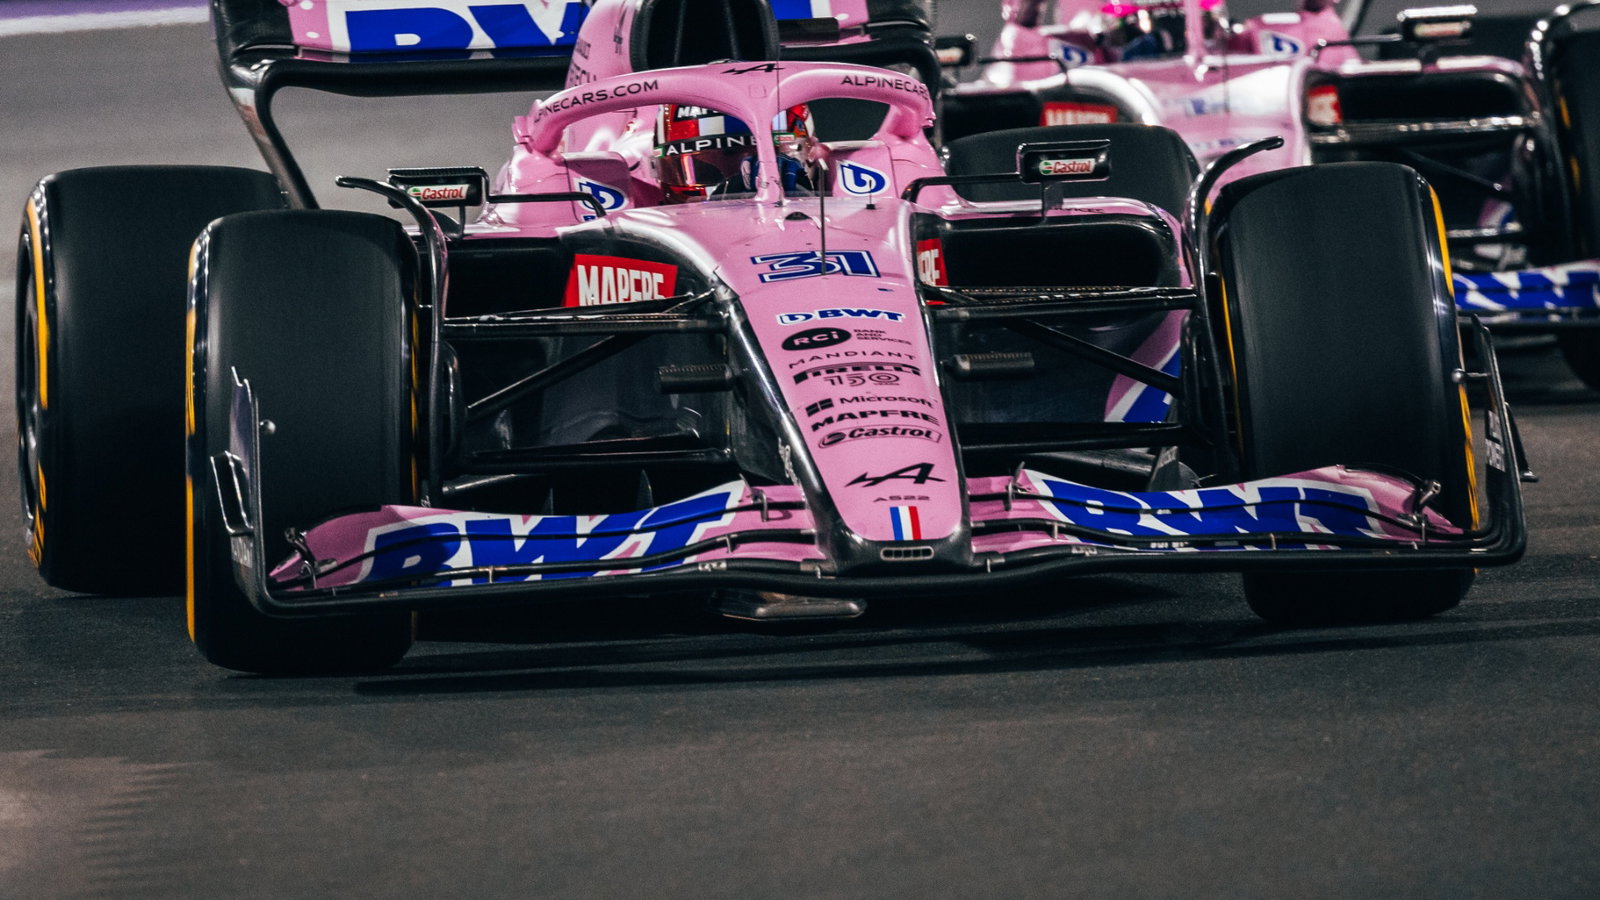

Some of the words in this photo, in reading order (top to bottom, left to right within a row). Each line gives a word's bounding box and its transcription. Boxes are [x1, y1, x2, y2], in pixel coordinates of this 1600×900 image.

[1053, 159, 1092, 174] Castrol
[421, 186, 464, 201] Castrol
[750, 250, 882, 283] 31
[817, 308, 903, 323] BWT
[788, 350, 916, 370] MANDIANT
[793, 362, 921, 385] PIRELLI
[840, 396, 938, 409] Microsoft
[811, 410, 940, 432] MAPFRE
[848, 427, 934, 439] Castrol
[1042, 479, 1377, 551] BWT
[367, 491, 732, 587] BWT
